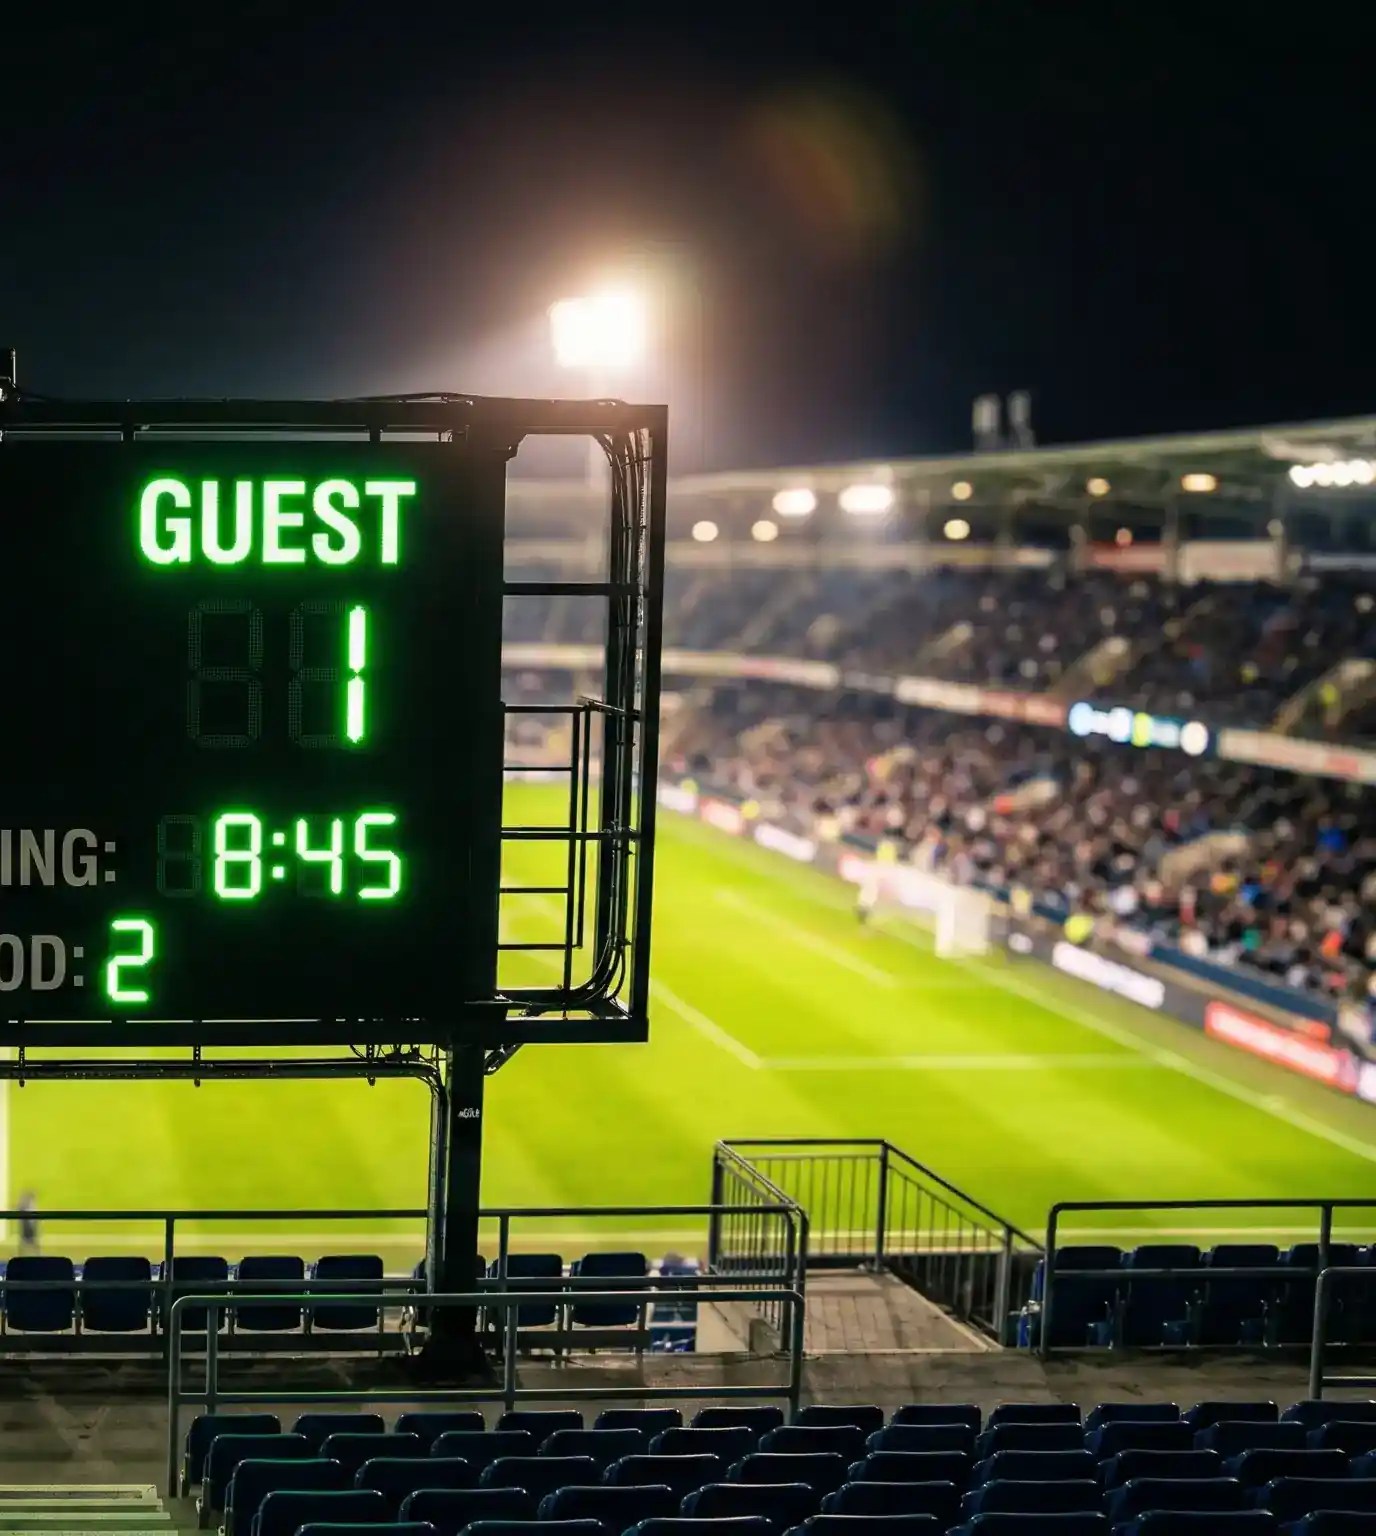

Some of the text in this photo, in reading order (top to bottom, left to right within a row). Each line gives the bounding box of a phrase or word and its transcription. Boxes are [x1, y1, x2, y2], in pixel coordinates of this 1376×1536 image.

[138, 477, 417, 567] GUEST
[344, 604, 369, 745] 1
[212, 810, 403, 901] 8:45
[104, 917, 156, 1004] 2
